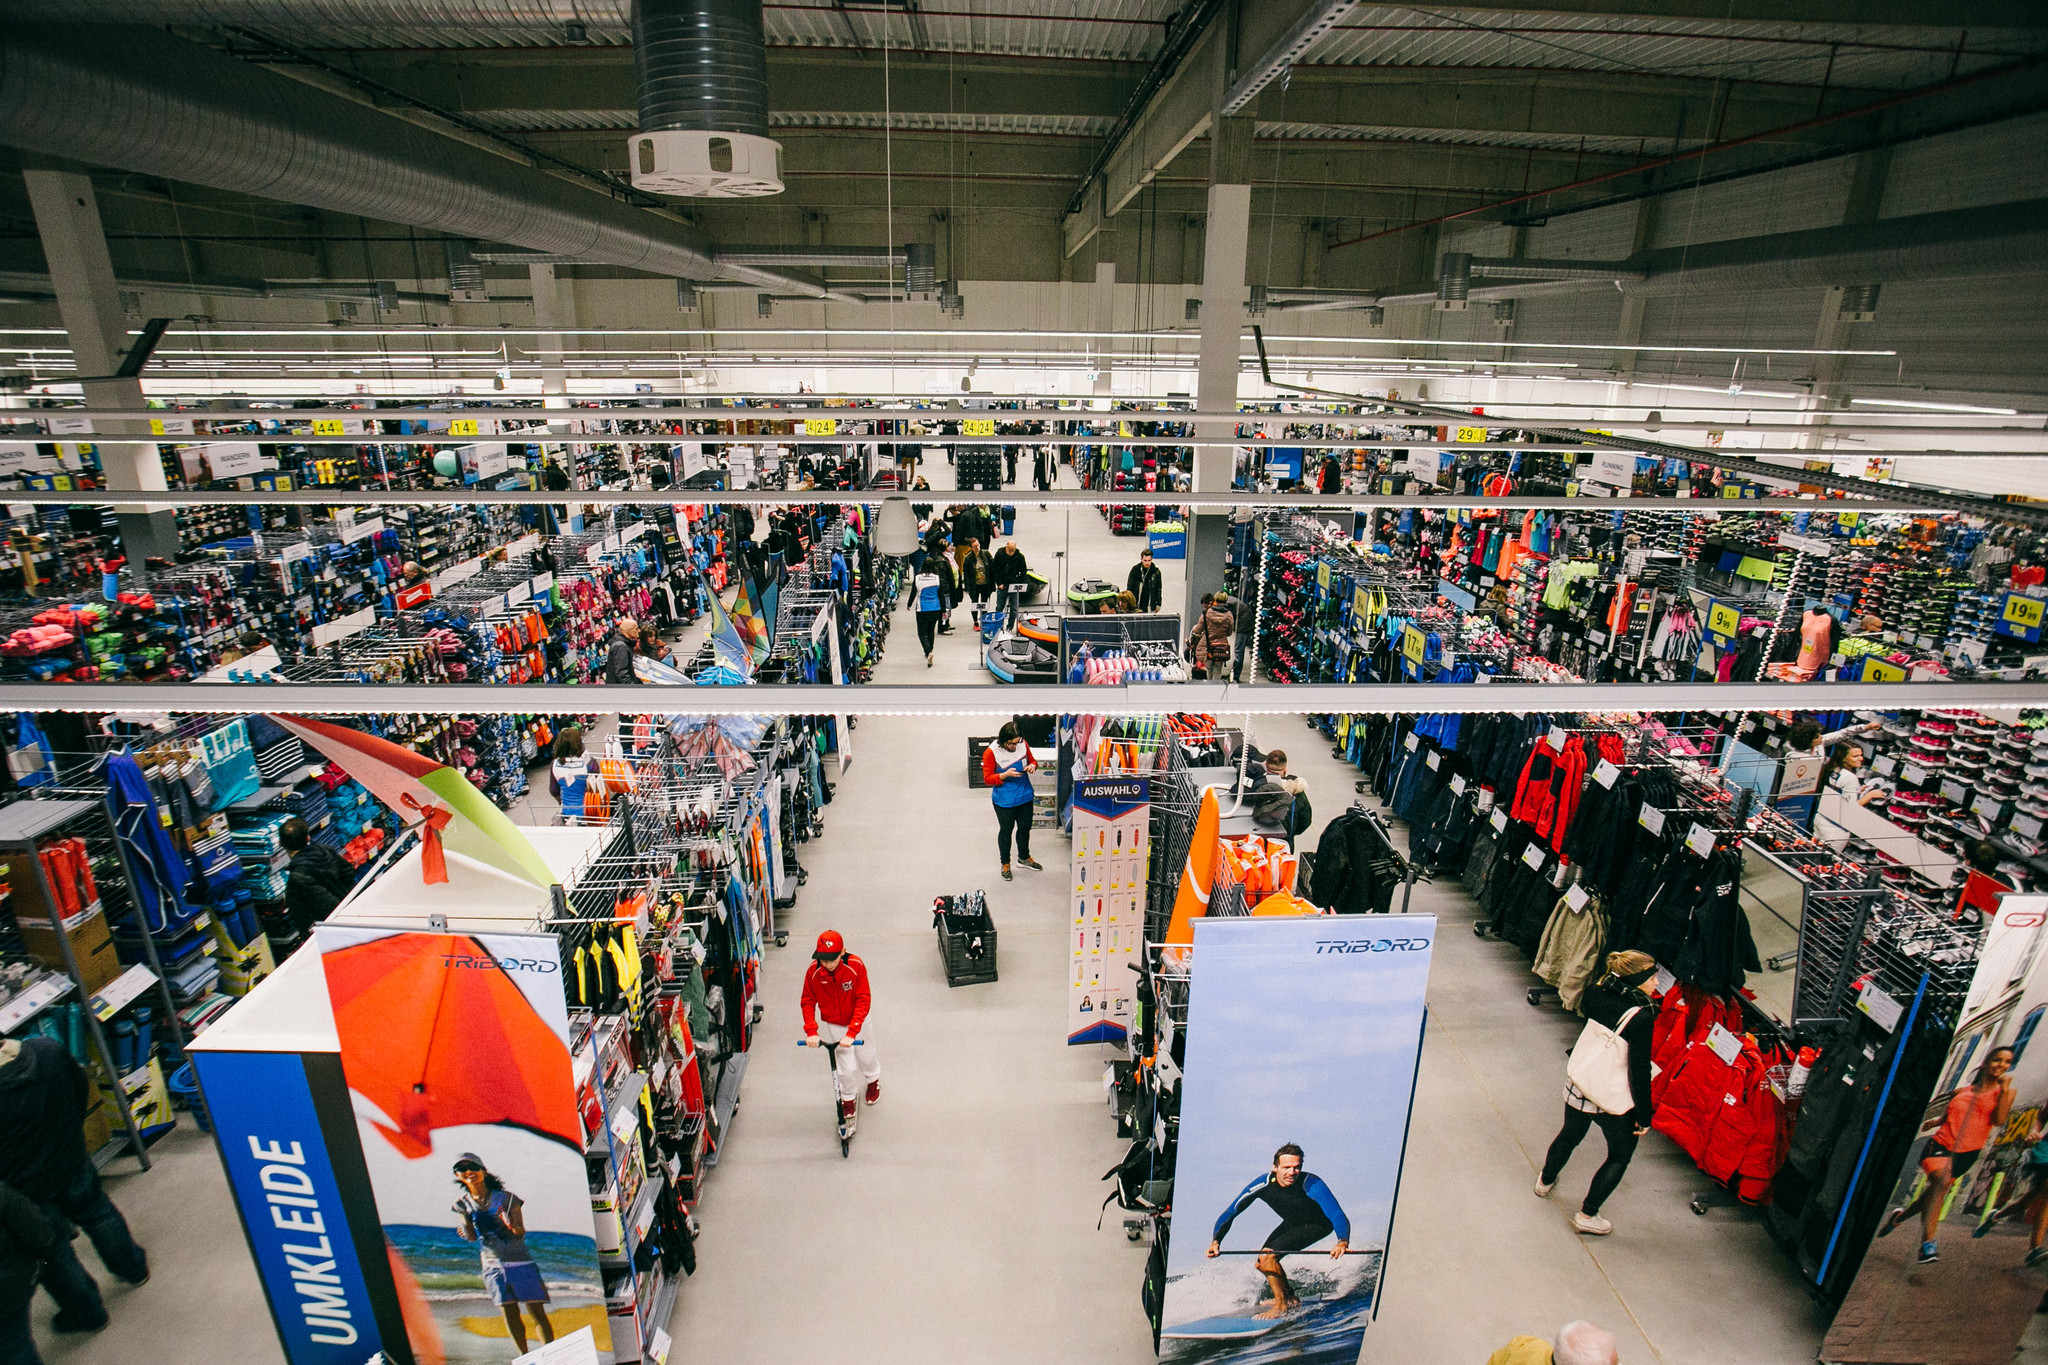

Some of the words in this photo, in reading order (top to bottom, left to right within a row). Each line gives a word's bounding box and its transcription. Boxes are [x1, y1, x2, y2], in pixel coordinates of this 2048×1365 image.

[318, 423, 335, 433] 44
[455, 422, 470, 433] 14
[817, 422, 829, 433] 24
[1458, 428, 1473, 440] 29
[1602, 460, 1624, 471] RUNNING
[1084, 785, 1132, 797] AUSWAHL
[248, 1135, 358, 1345] UMKLEIDE
